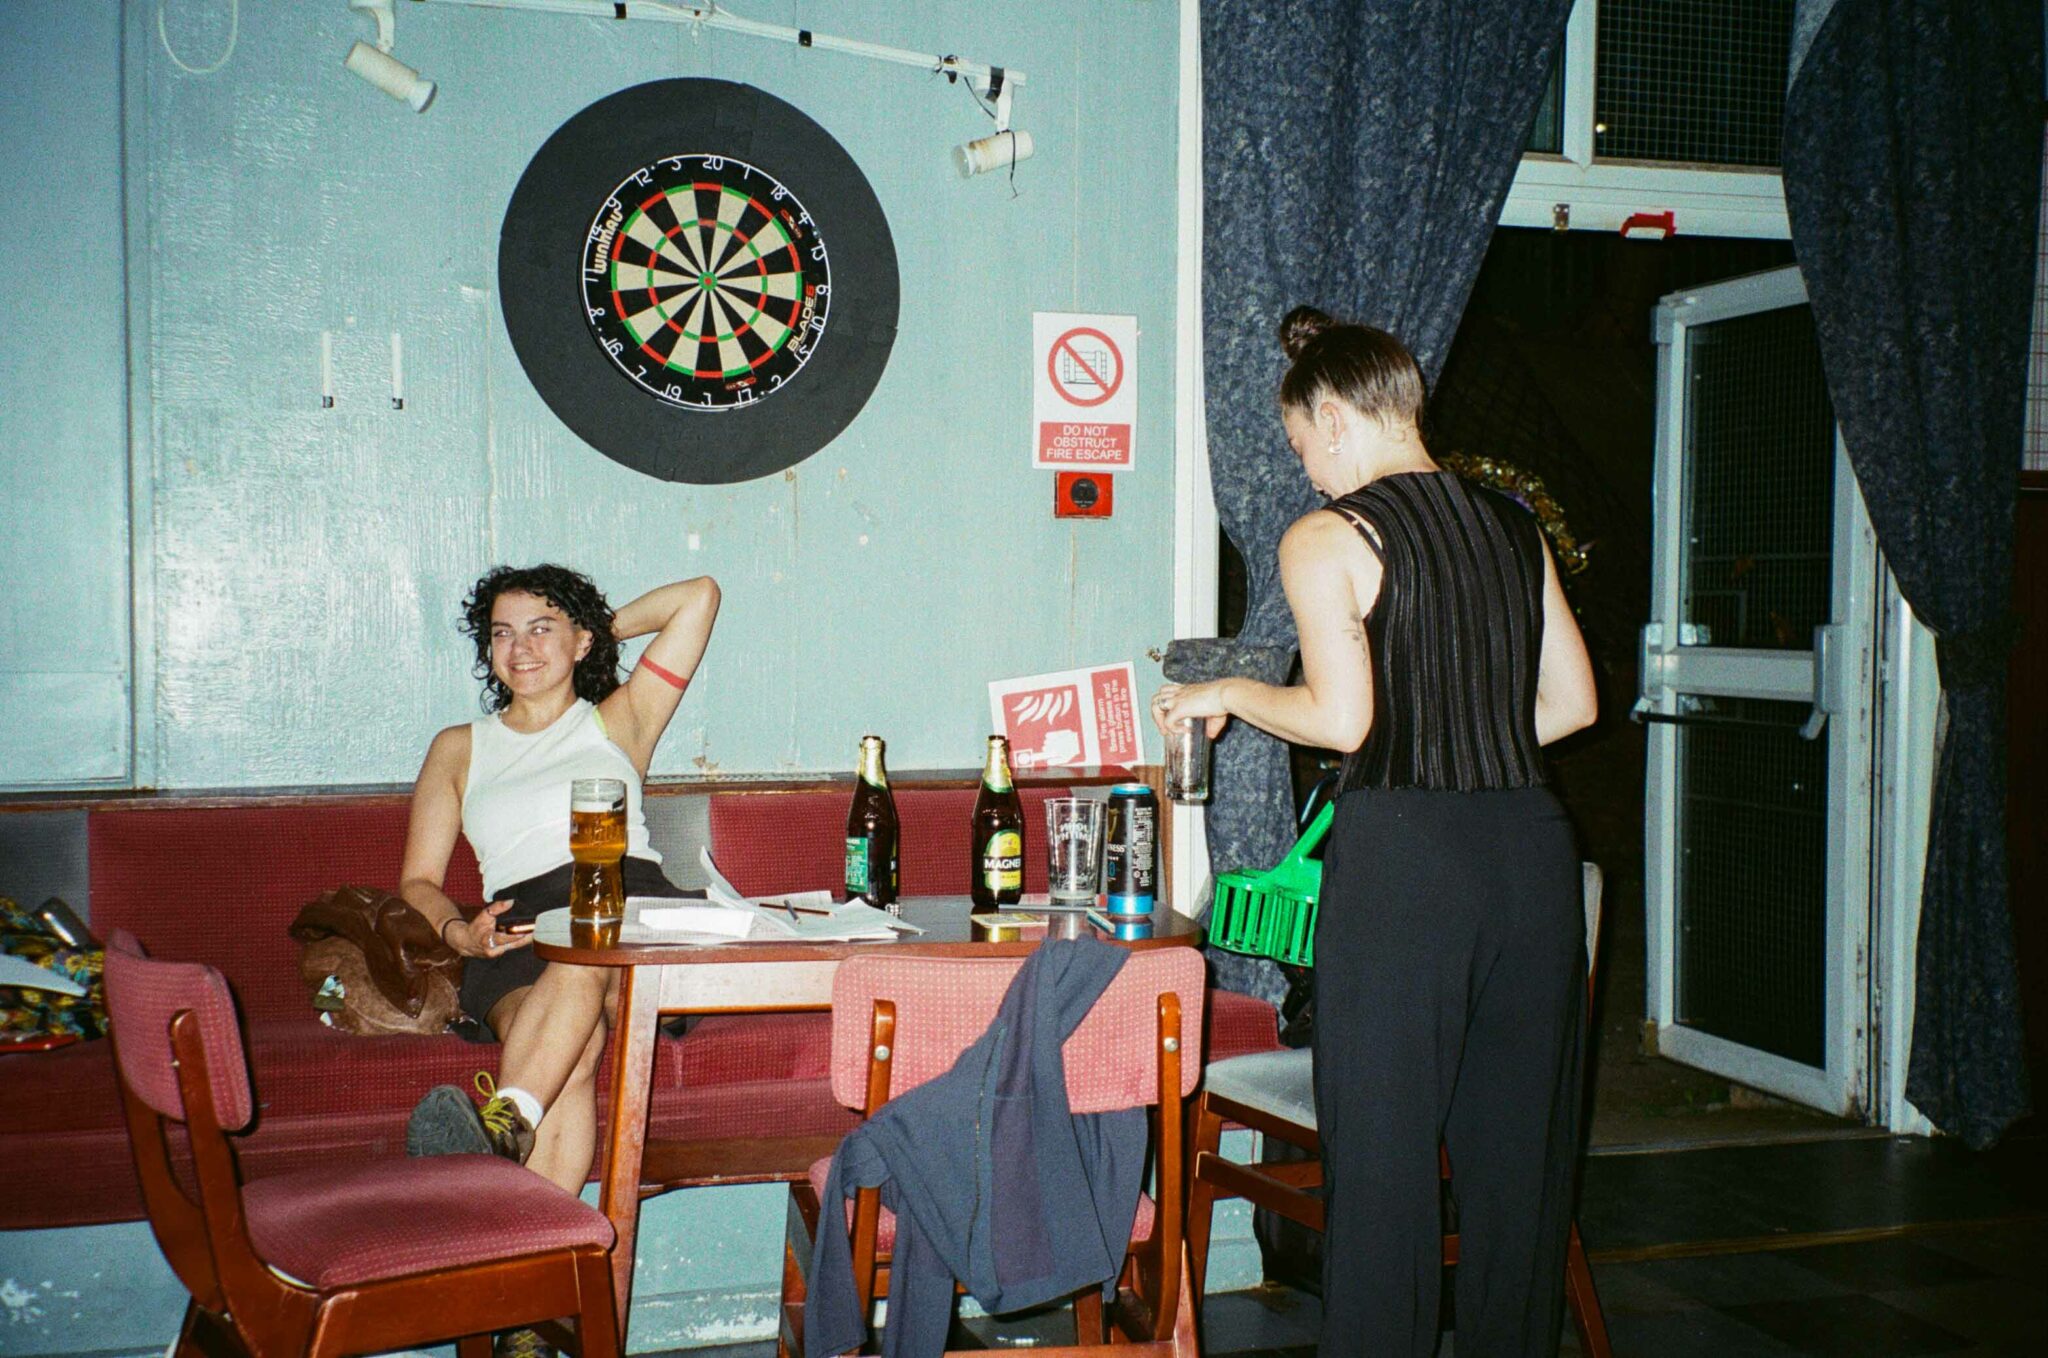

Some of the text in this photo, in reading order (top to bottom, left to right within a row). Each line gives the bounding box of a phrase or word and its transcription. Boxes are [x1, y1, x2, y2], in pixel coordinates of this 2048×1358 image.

[702, 156, 724, 171] 20
[742, 163, 751, 180] 1
[630, 167, 653, 187] 12
[771, 182, 788, 201] 18
[607, 197, 622, 210] 9
[798, 211, 811, 225] 4
[816, 284, 831, 296] 6
[589, 307, 606, 317] 8
[810, 316, 825, 336] 10
[604, 337, 624, 356] 16
[794, 344, 812, 366] 15
[635, 364, 648, 380] 7
[660, 383, 682, 400] 19
[735, 388, 753, 405] 17
[1063, 425, 1108, 436] DO NOT
[1053, 436, 1117, 448] OBSTRUCT
[1046, 448, 1122, 460] FIRE ESCAPE
